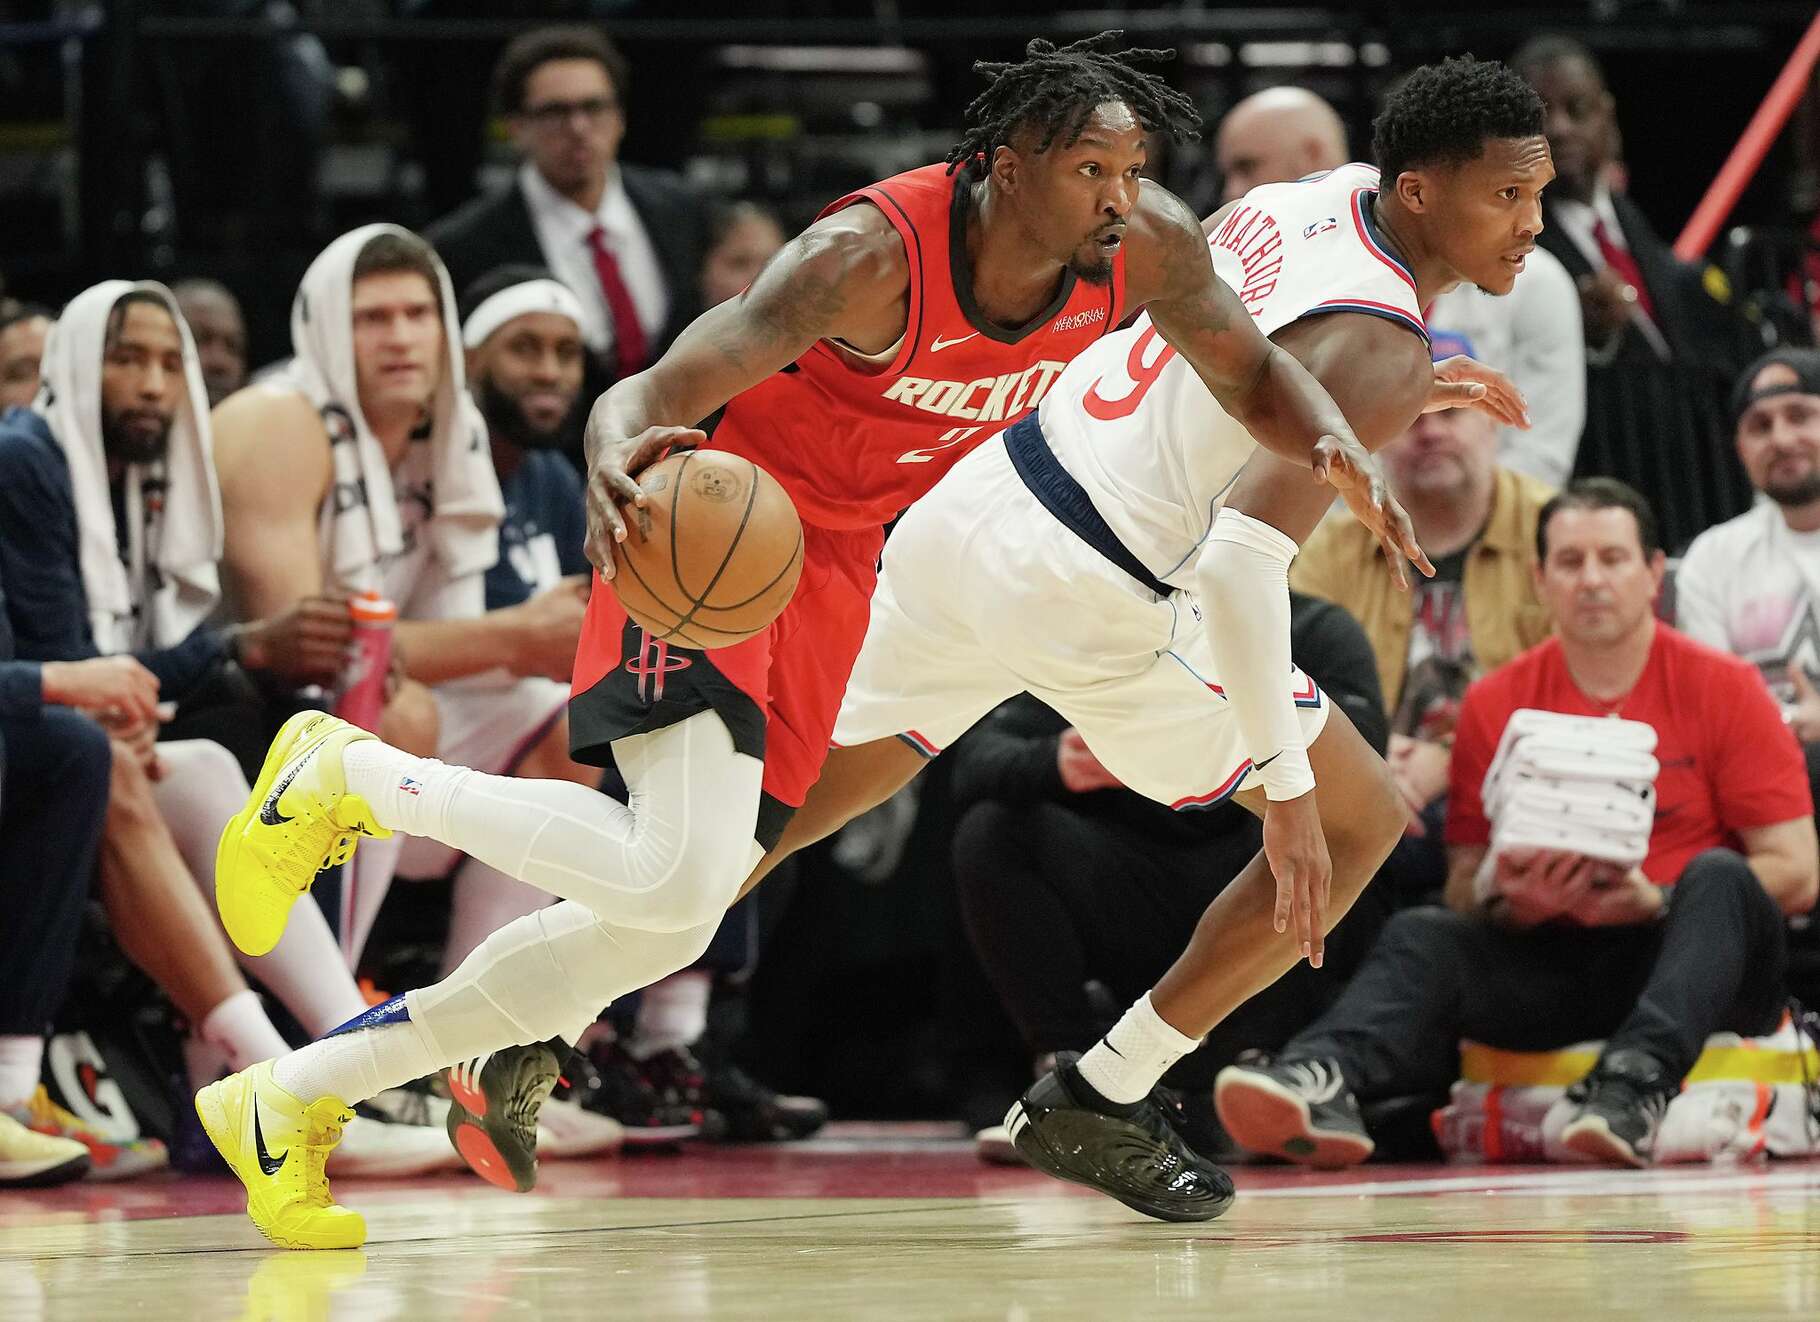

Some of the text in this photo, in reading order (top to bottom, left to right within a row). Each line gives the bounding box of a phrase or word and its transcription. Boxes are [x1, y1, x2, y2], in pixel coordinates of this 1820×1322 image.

[1210, 206, 1283, 317] MATHUR
[1052, 313, 1105, 333] HERMANN
[1055, 306, 1104, 325] MEMORIAL
[881, 359, 1068, 422] ROCKET
[1082, 323, 1177, 421] 9
[895, 425, 985, 464] 2
